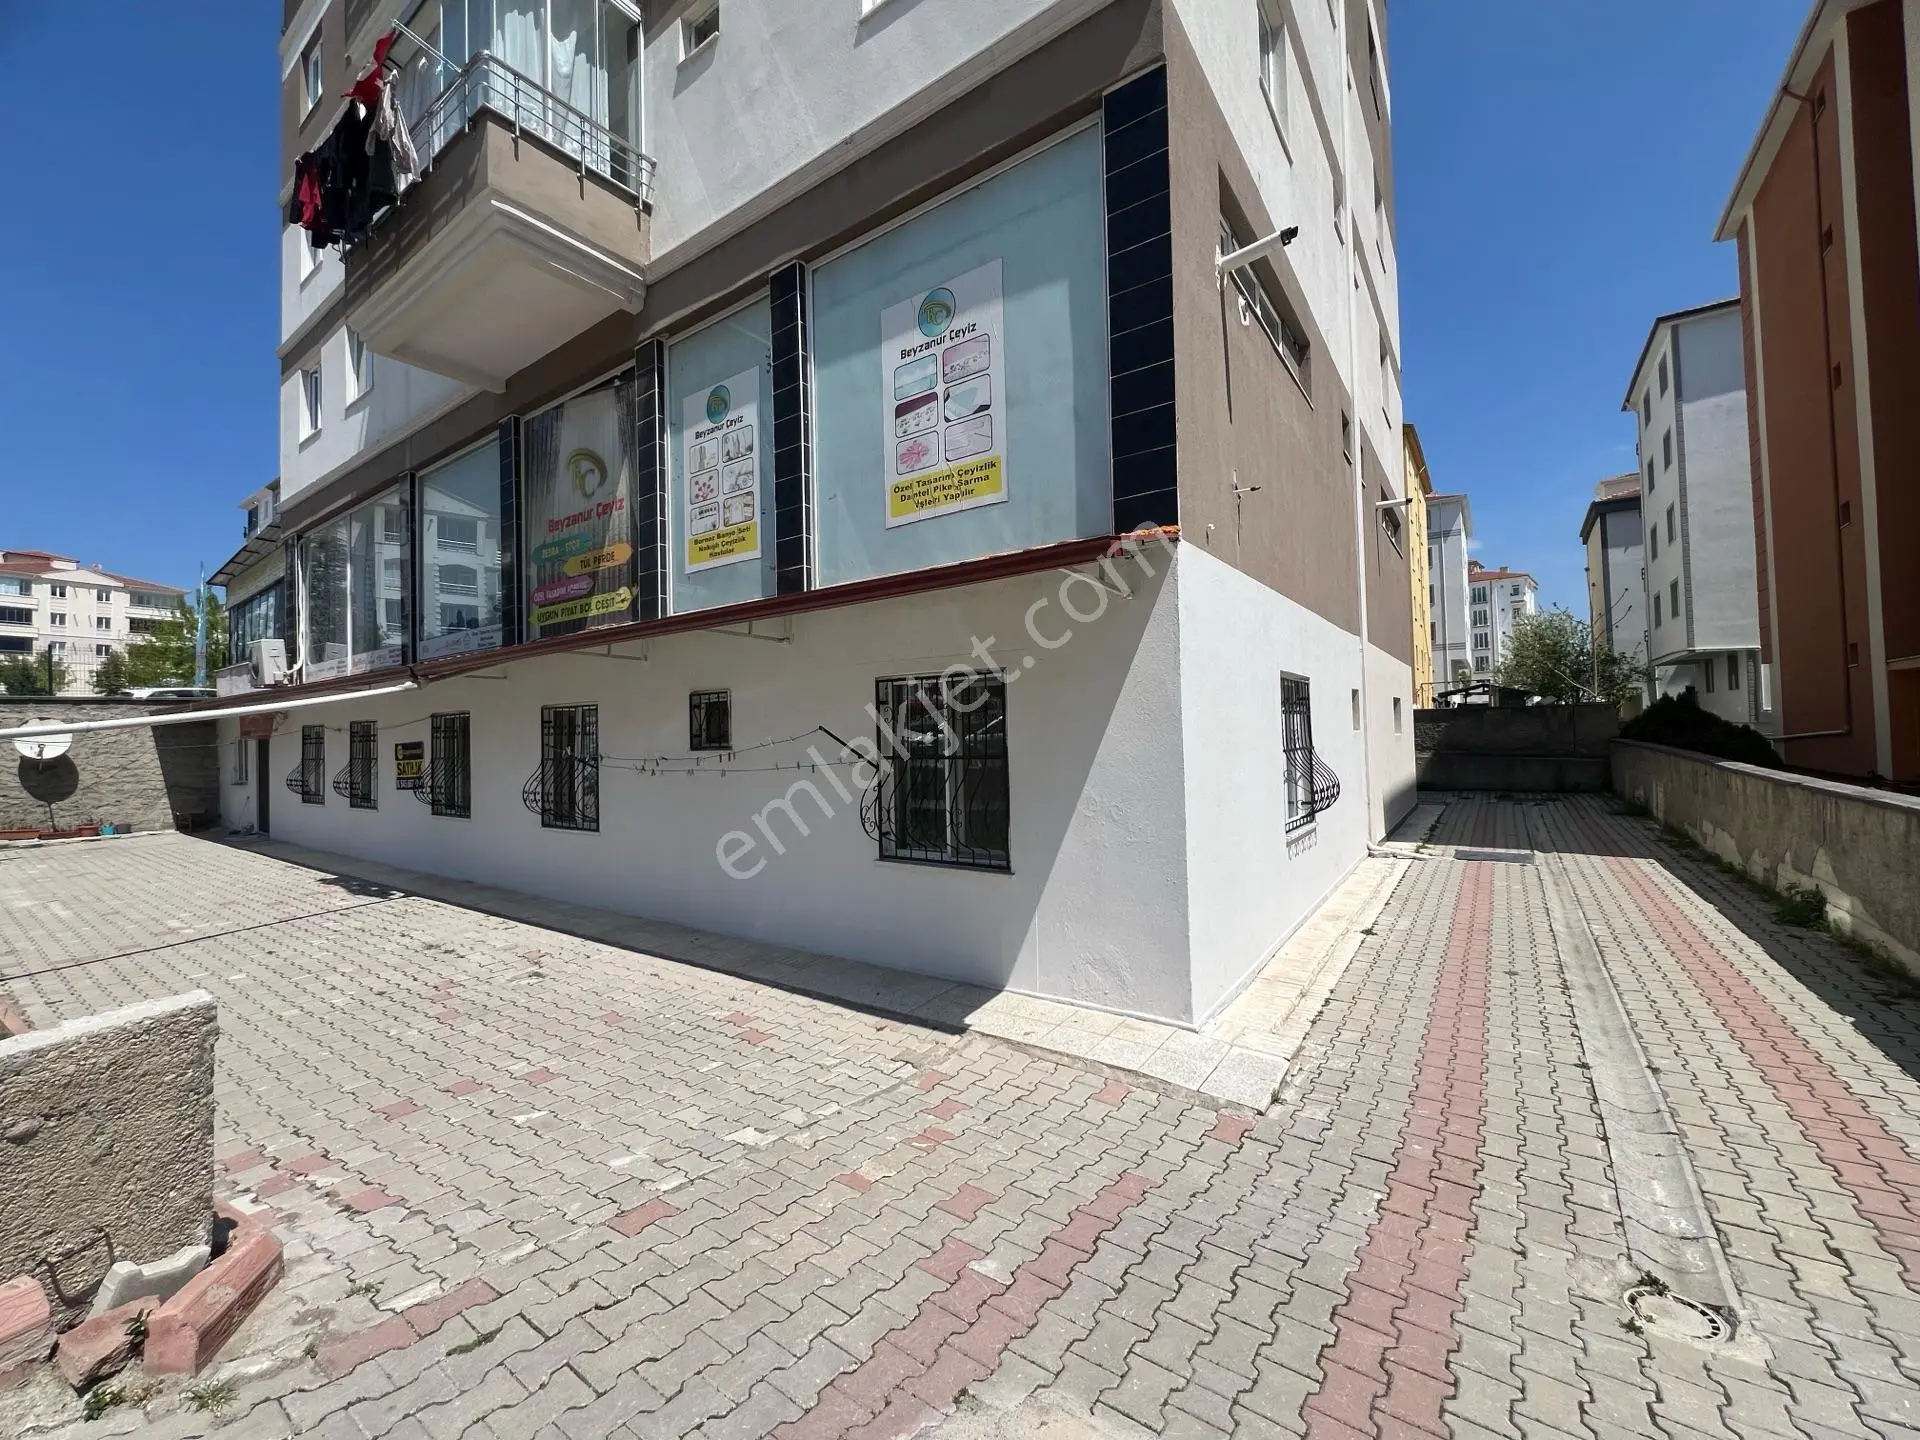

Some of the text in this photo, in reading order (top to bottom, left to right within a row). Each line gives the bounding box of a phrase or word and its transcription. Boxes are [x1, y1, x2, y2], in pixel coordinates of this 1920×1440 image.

[900, 334, 947, 360] Beyzanur
[695, 422, 725, 440] Beyzanur
[957, 460, 998, 479] Çeyizlik
[900, 488, 930, 502] Dantel
[957, 474, 990, 488] Sarma
[547, 507, 594, 535] Beyzanur
